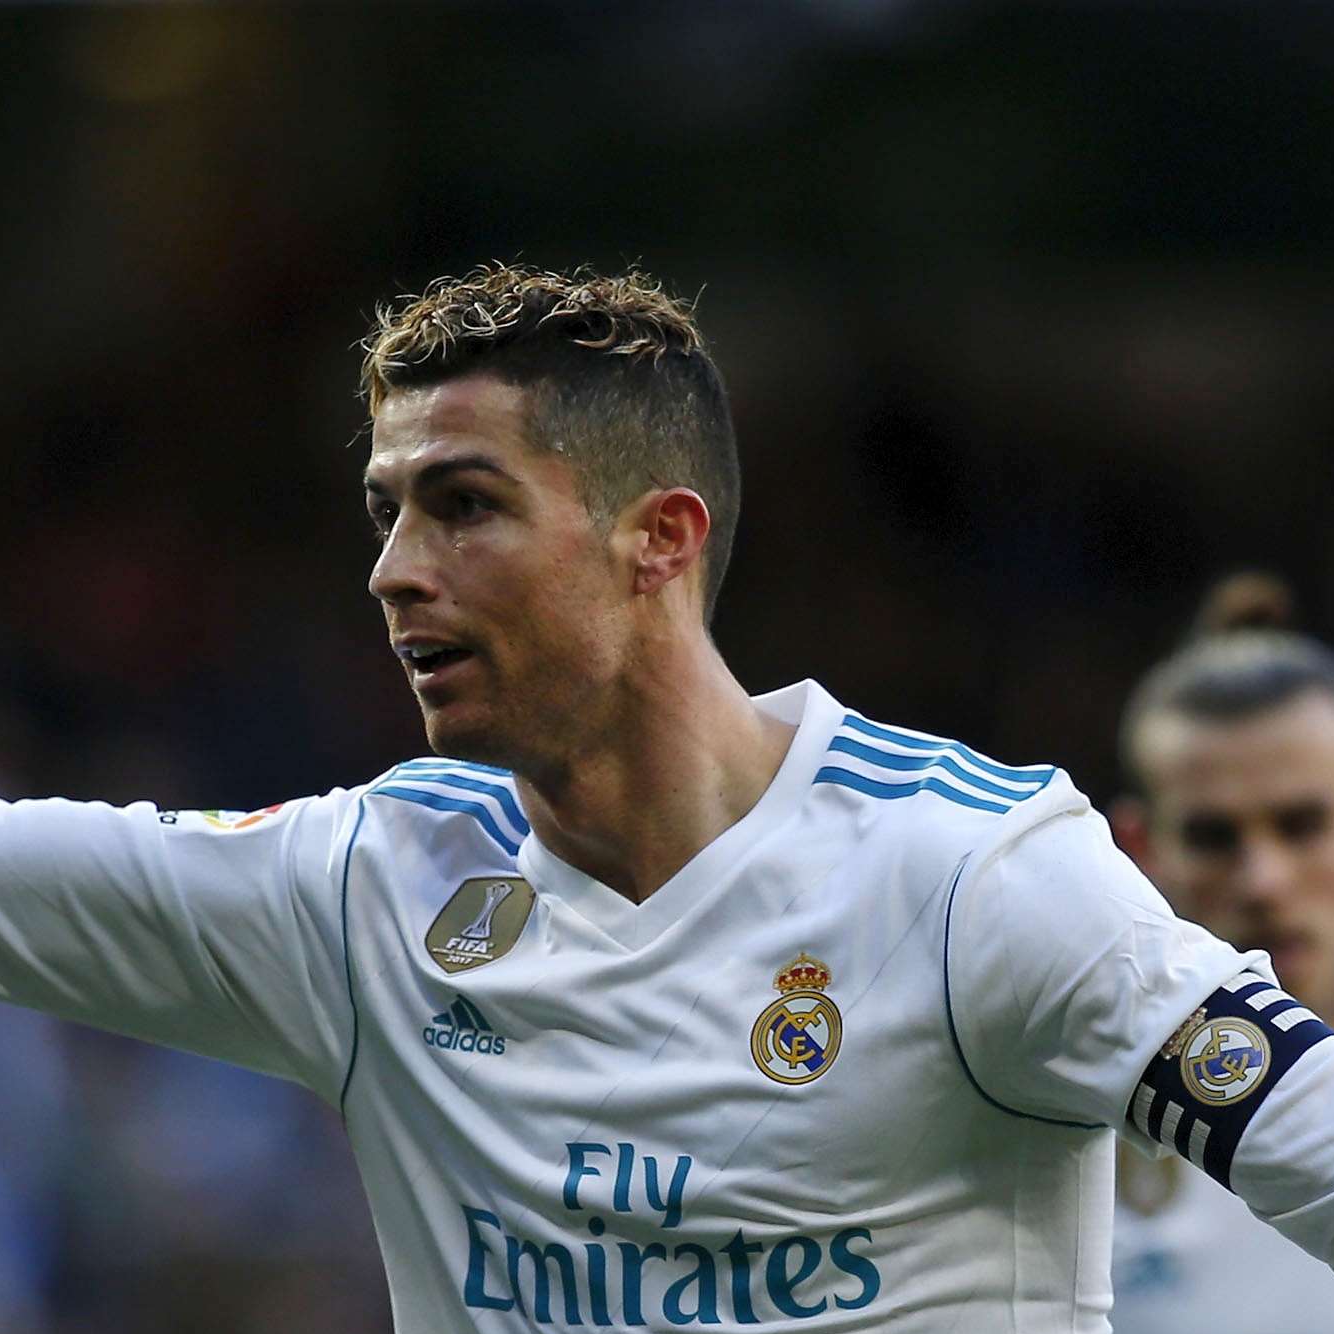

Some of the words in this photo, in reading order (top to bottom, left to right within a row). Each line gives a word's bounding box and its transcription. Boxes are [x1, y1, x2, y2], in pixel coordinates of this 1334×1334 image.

[445, 936, 488, 954] FIFA
[422, 1024, 506, 1055] adidas
[562, 1141, 693, 1228] Fly
[462, 1203, 882, 1326] Emirates
